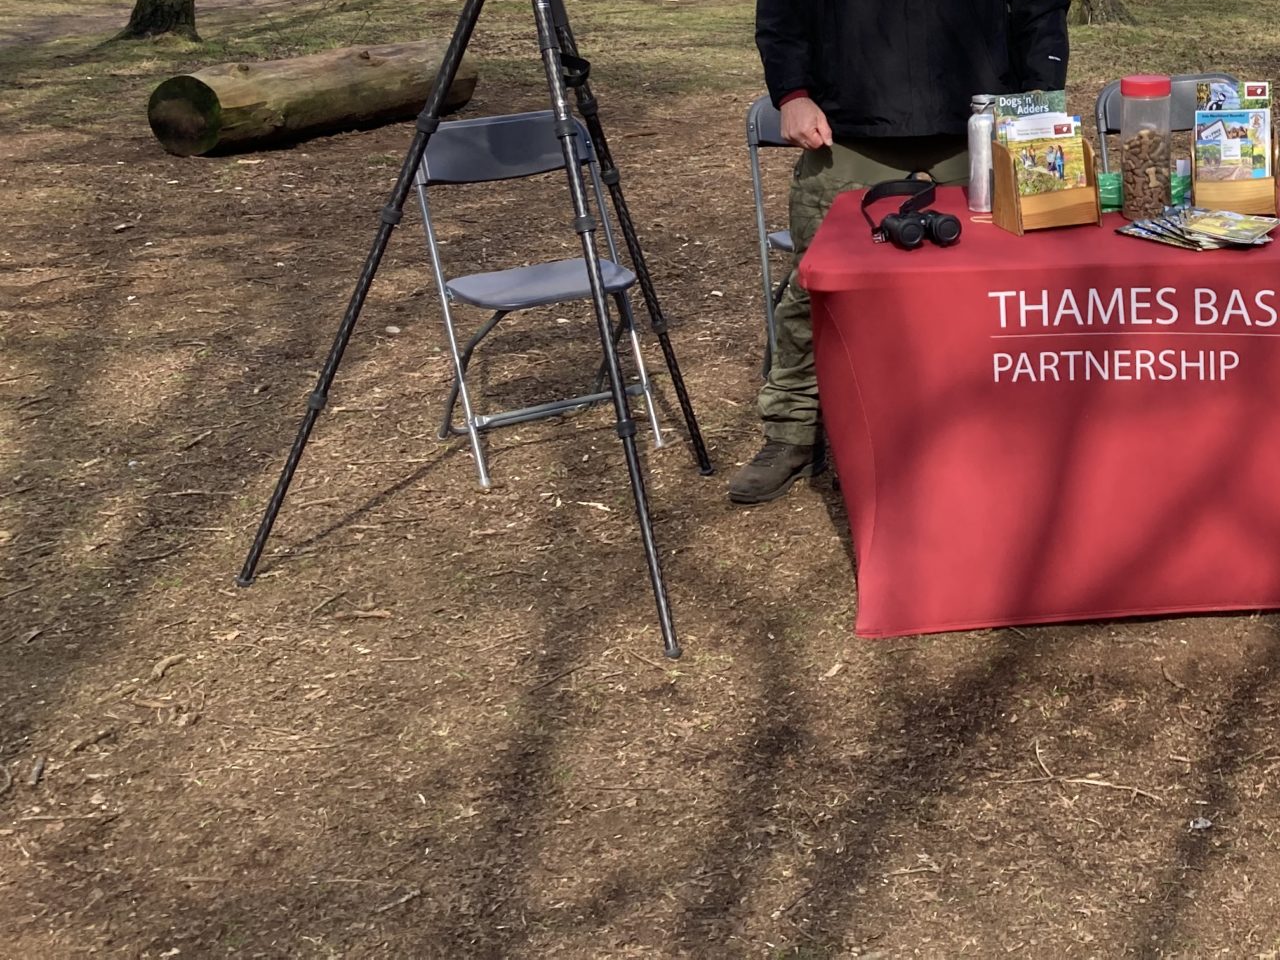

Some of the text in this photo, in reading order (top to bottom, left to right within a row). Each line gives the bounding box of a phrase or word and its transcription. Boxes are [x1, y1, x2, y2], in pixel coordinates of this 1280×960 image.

[999, 97, 1022, 108] Dogs
[1017, 103, 1050, 115] Adders
[987, 287, 1179, 328] THAMES
[993, 349, 1240, 383] PARTNERSHIP
